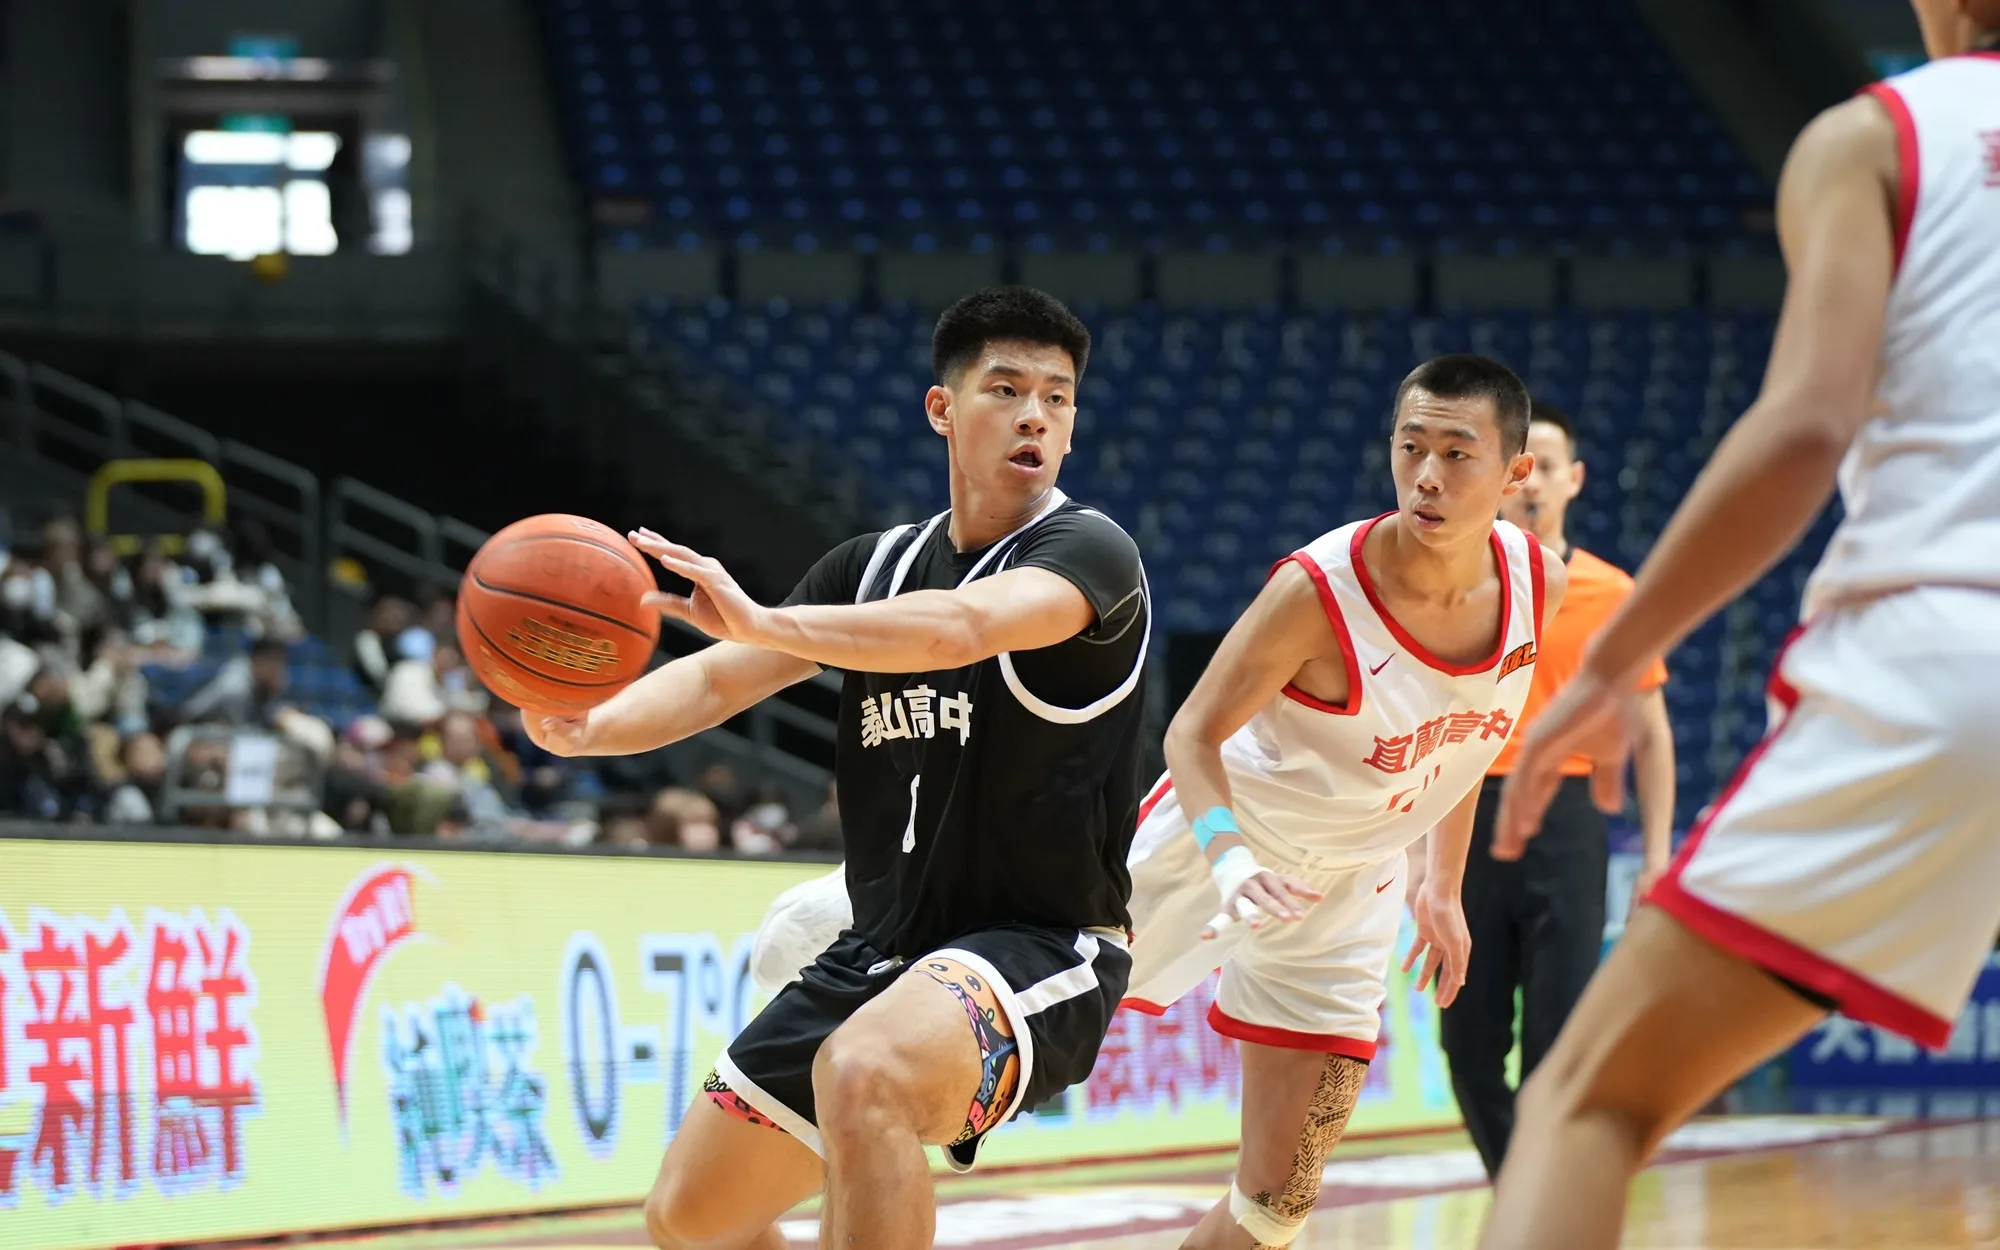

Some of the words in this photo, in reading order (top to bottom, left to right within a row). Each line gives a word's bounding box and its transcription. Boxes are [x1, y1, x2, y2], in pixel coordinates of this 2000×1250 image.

[861, 684, 974, 748] 泰山高中
[1362, 708, 1514, 774] 宜蘭高中
[0, 916, 258, 1198] 新鮮
